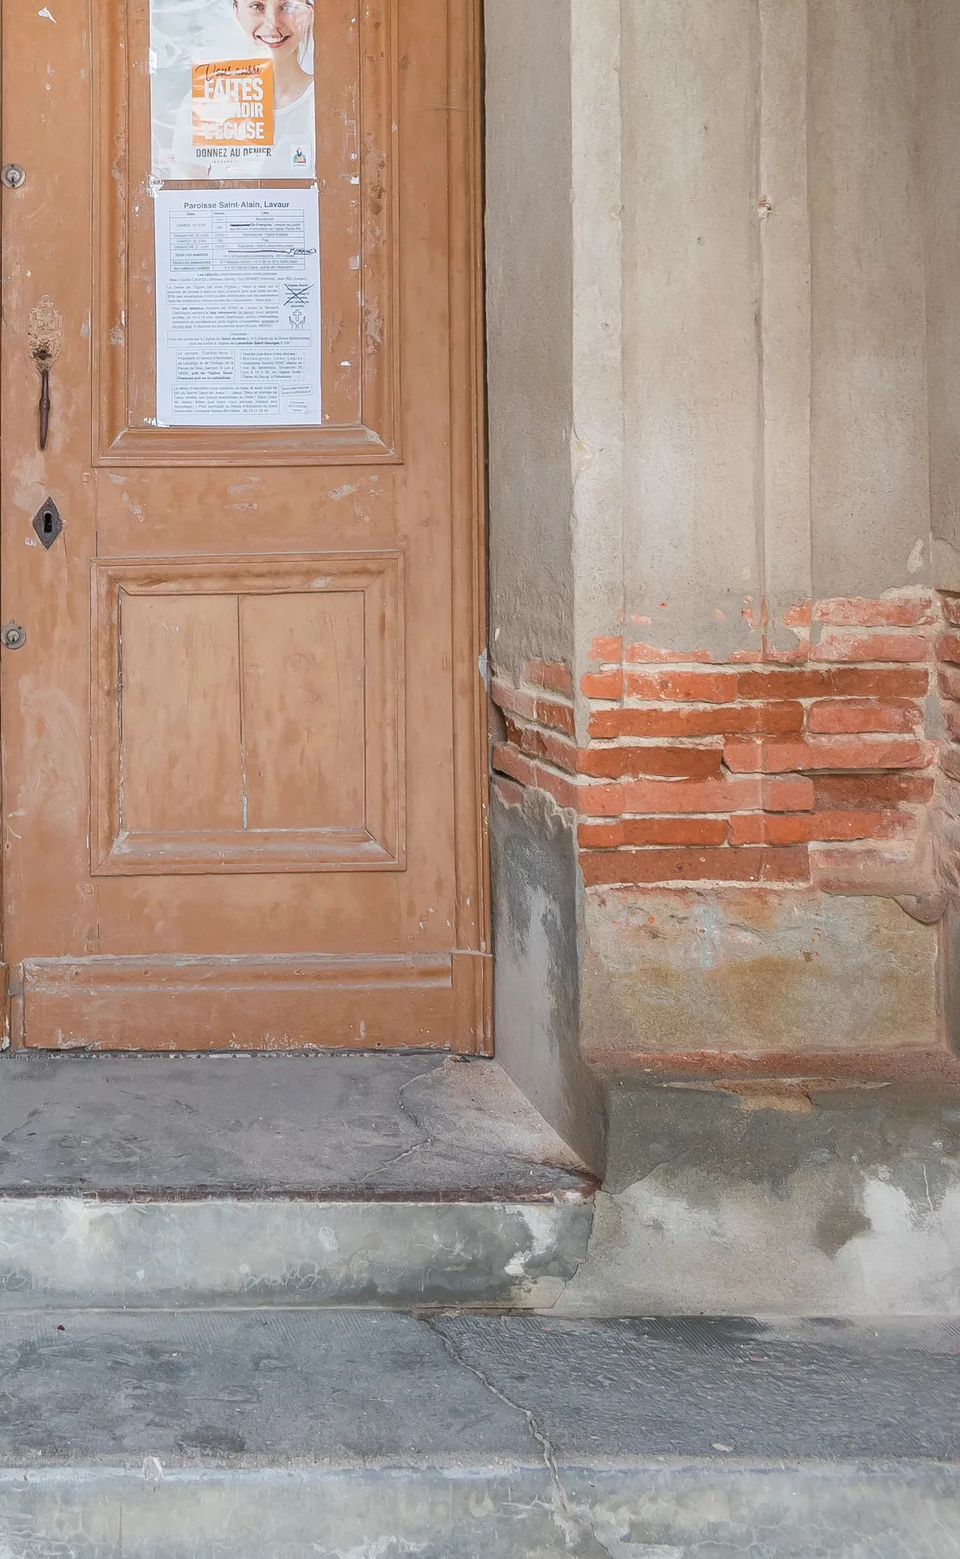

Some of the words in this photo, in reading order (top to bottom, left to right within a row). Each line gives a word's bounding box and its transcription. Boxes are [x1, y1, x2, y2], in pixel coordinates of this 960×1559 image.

[204, 78, 264, 101] FAITES
[195, 148, 228, 158] DONNEZ
[229, 148, 240, 157] AU
[243, 147, 272, 157] DENIER
[218, 201, 262, 209] Saint-Alain,
